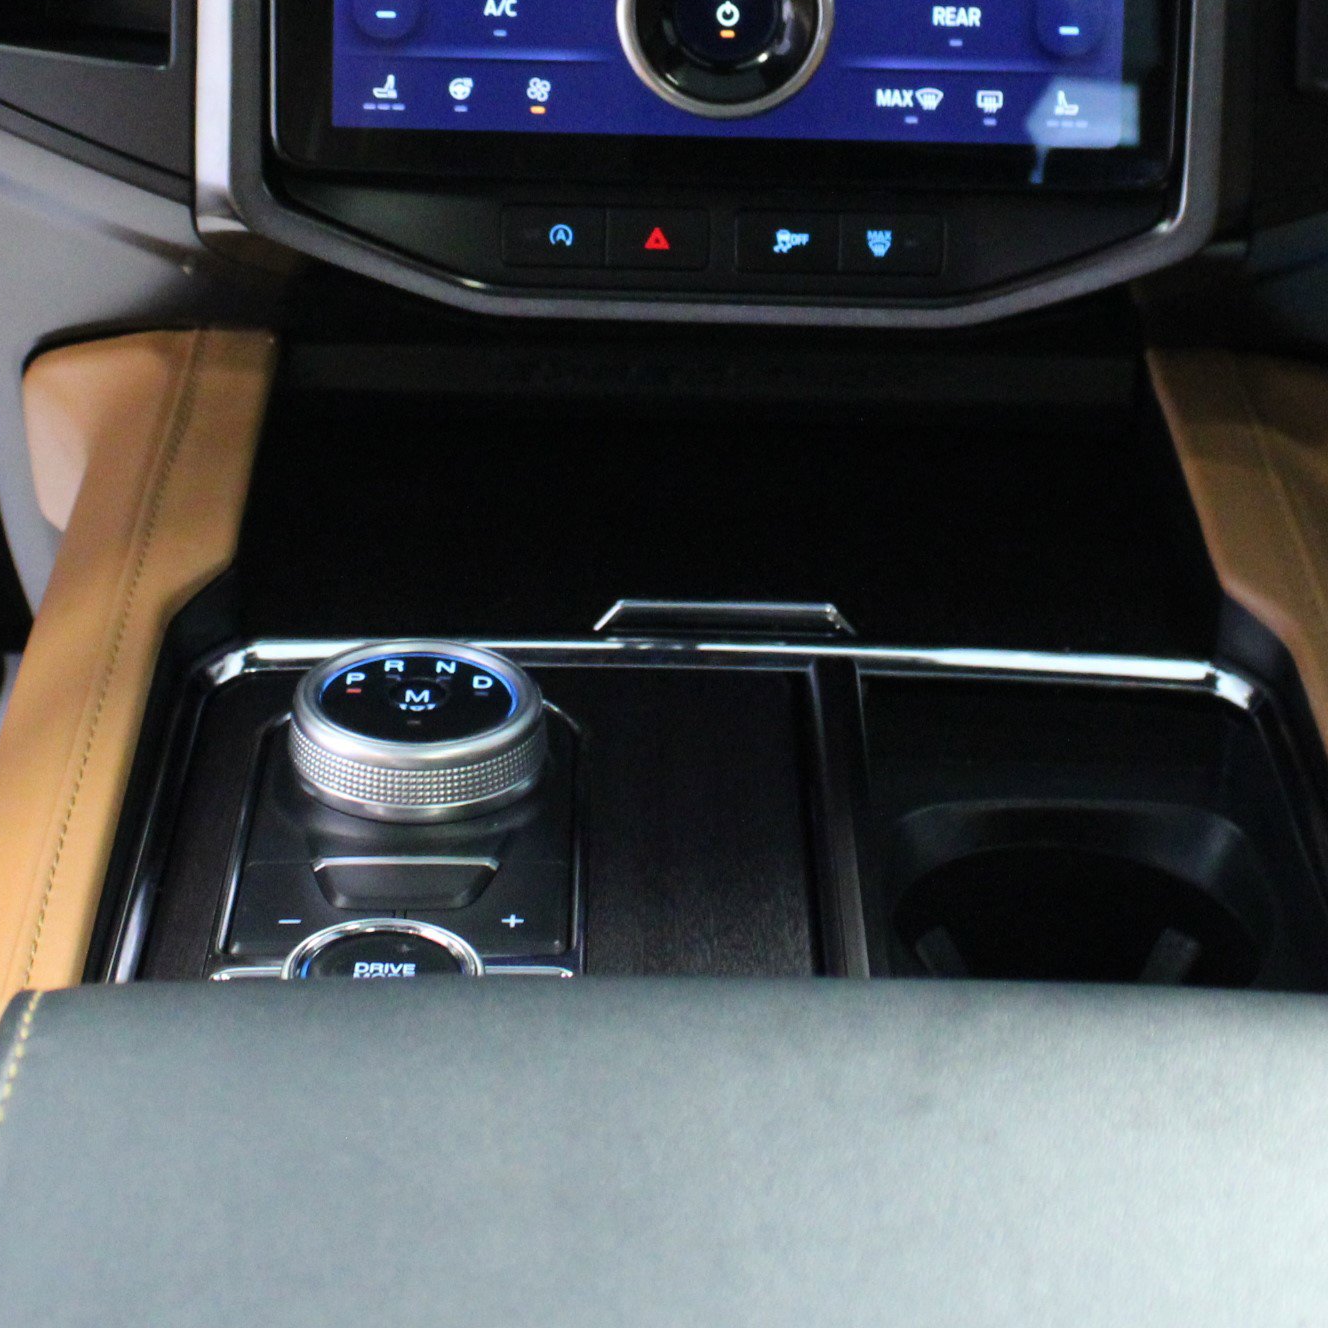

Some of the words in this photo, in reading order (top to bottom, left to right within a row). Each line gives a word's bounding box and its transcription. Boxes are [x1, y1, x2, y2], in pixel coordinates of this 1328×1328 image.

[932, 6, 981, 27] REAR
[876, 88, 914, 108] MAX
[384, 660, 405, 673] R
[436, 661, 456, 674] N
[346, 673, 365, 685] P
[472, 676, 493, 689] D
[405, 689, 430, 704] M
[353, 961, 416, 975] DRIVE
